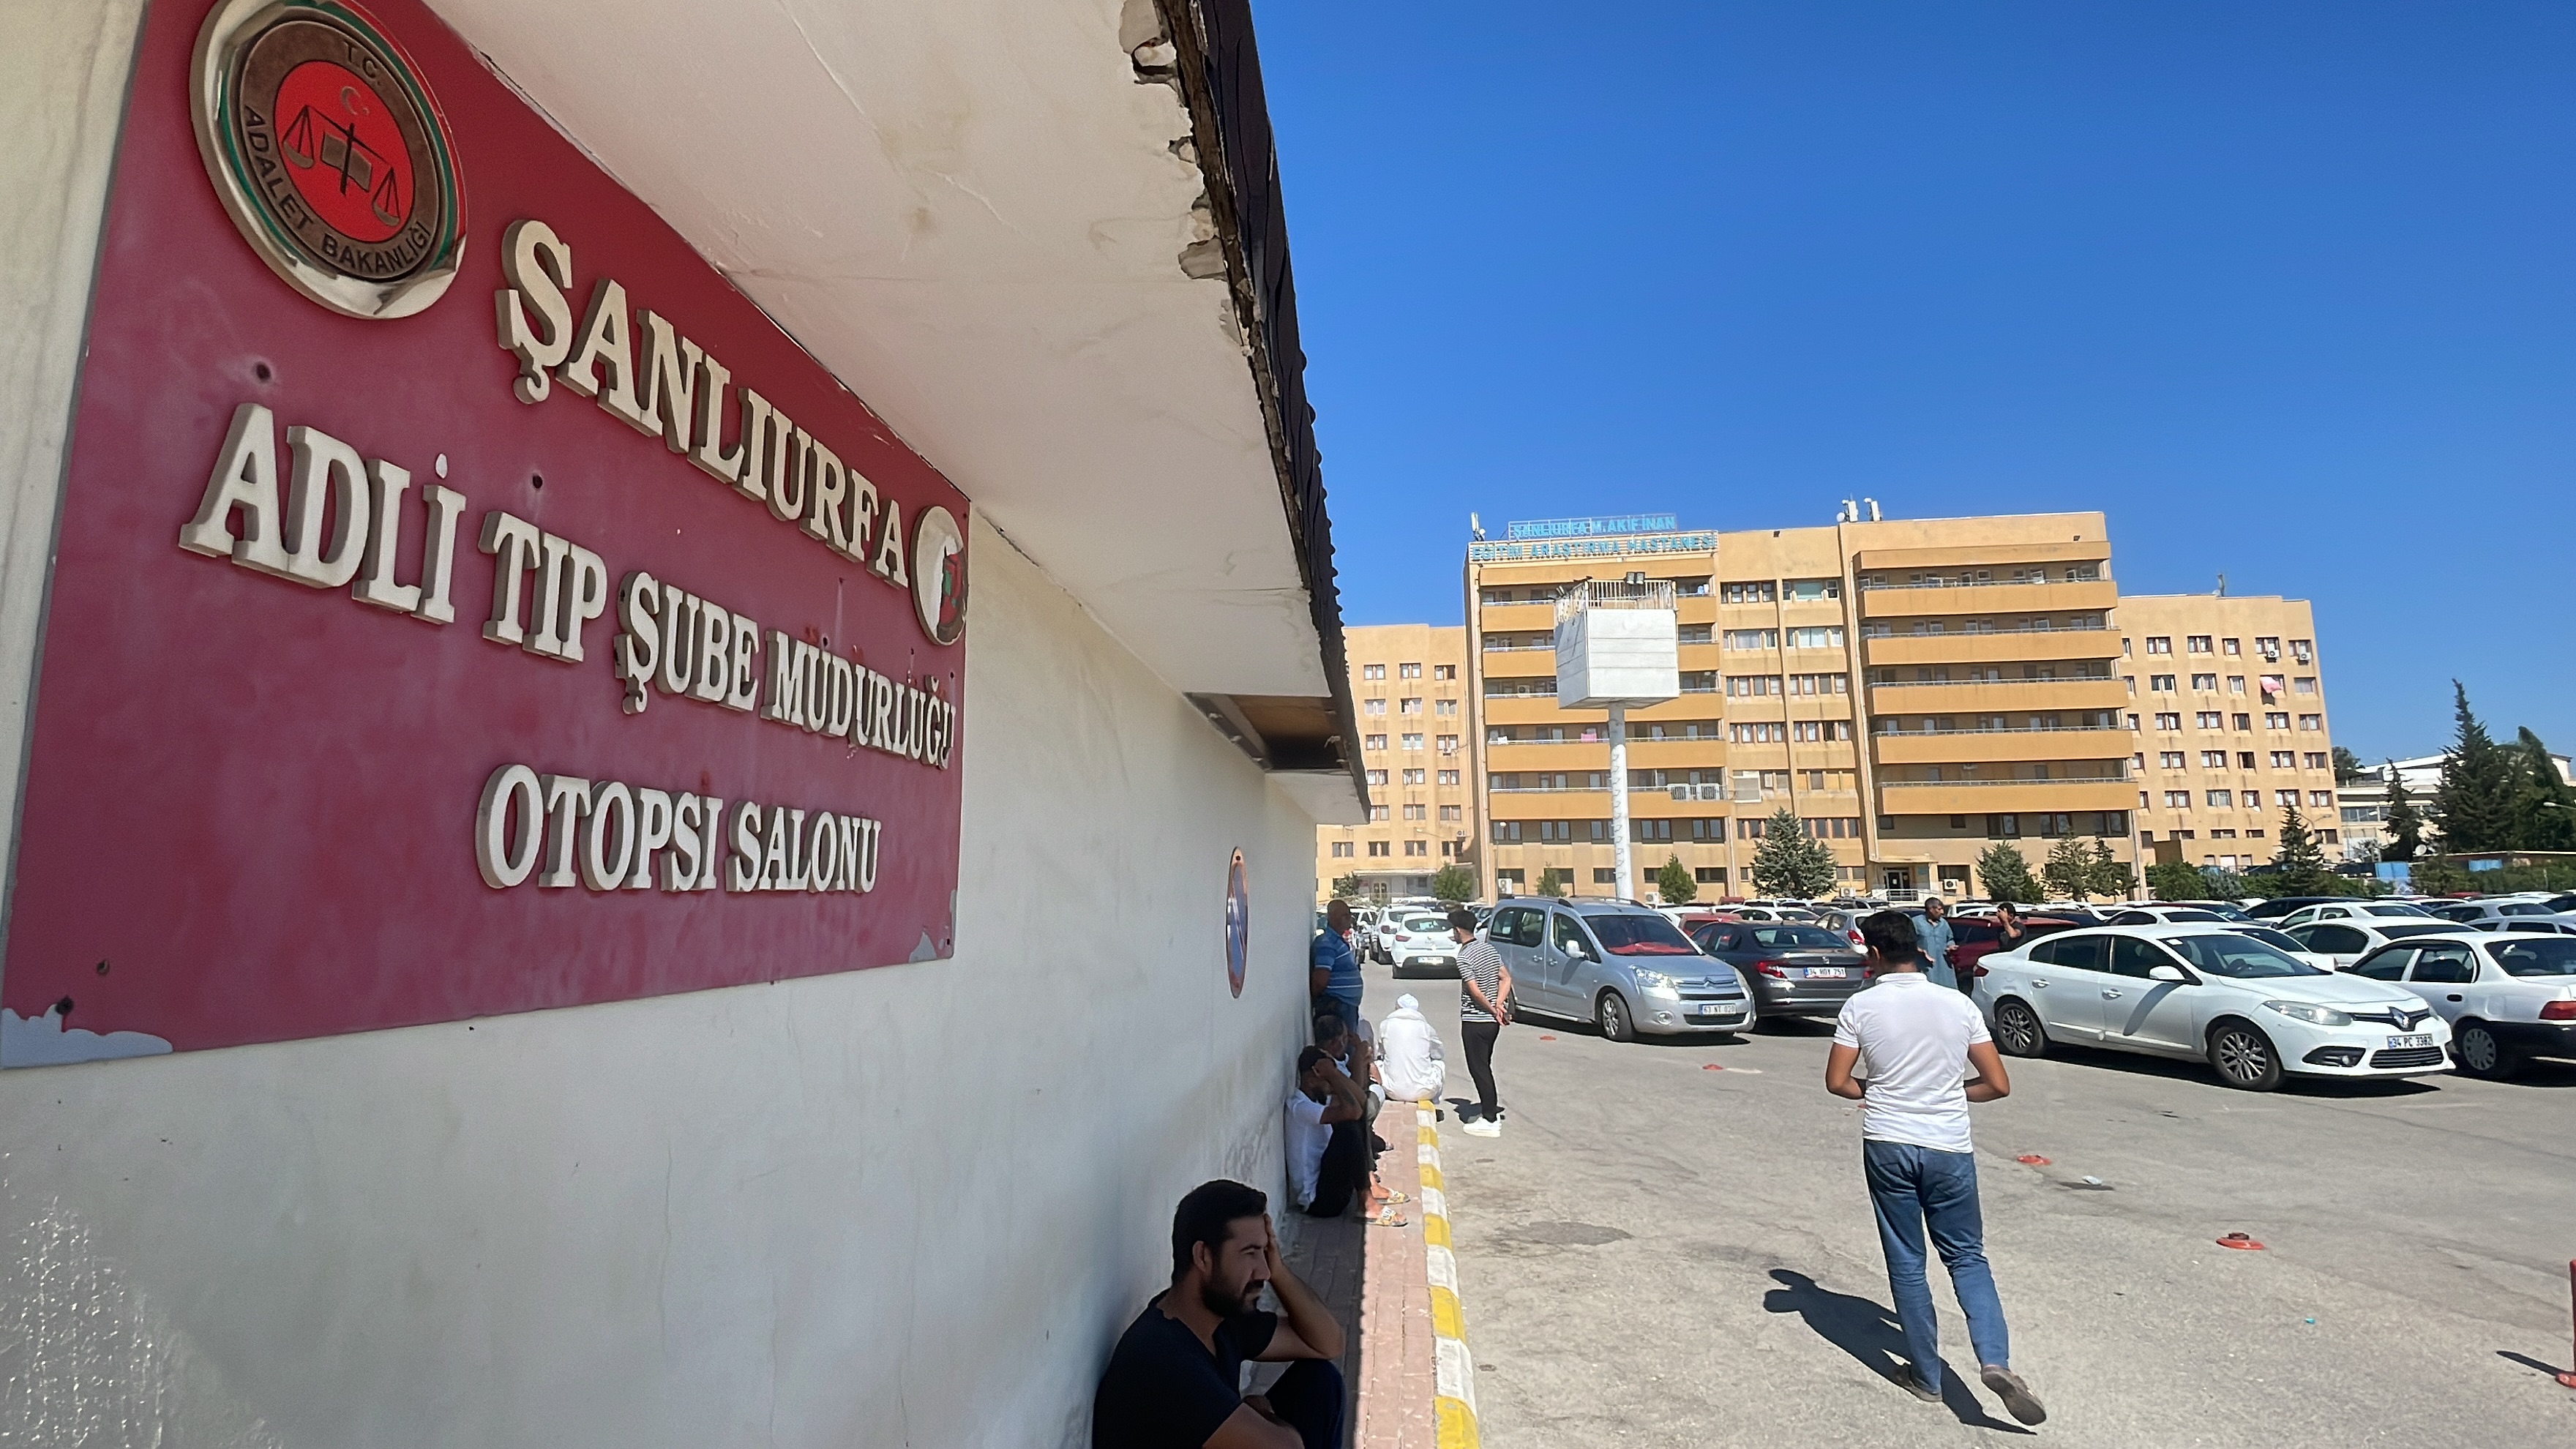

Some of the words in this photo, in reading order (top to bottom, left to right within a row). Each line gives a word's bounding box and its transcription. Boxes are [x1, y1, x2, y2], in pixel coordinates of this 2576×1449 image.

[244, 104, 313, 231] ADALET
[321, 221, 431, 273] BAKANLIĞI
[495, 220, 907, 588] ŞANLIURFA
[179, 402, 466, 624] ADLİ
[479, 512, 607, 663] TIP
[614, 572, 760, 714] ŞUBE
[725, 801, 881, 893] SALONU
[2392, 1038, 2401, 1047] 34
[2403, 1037, 2413, 1046] PC
